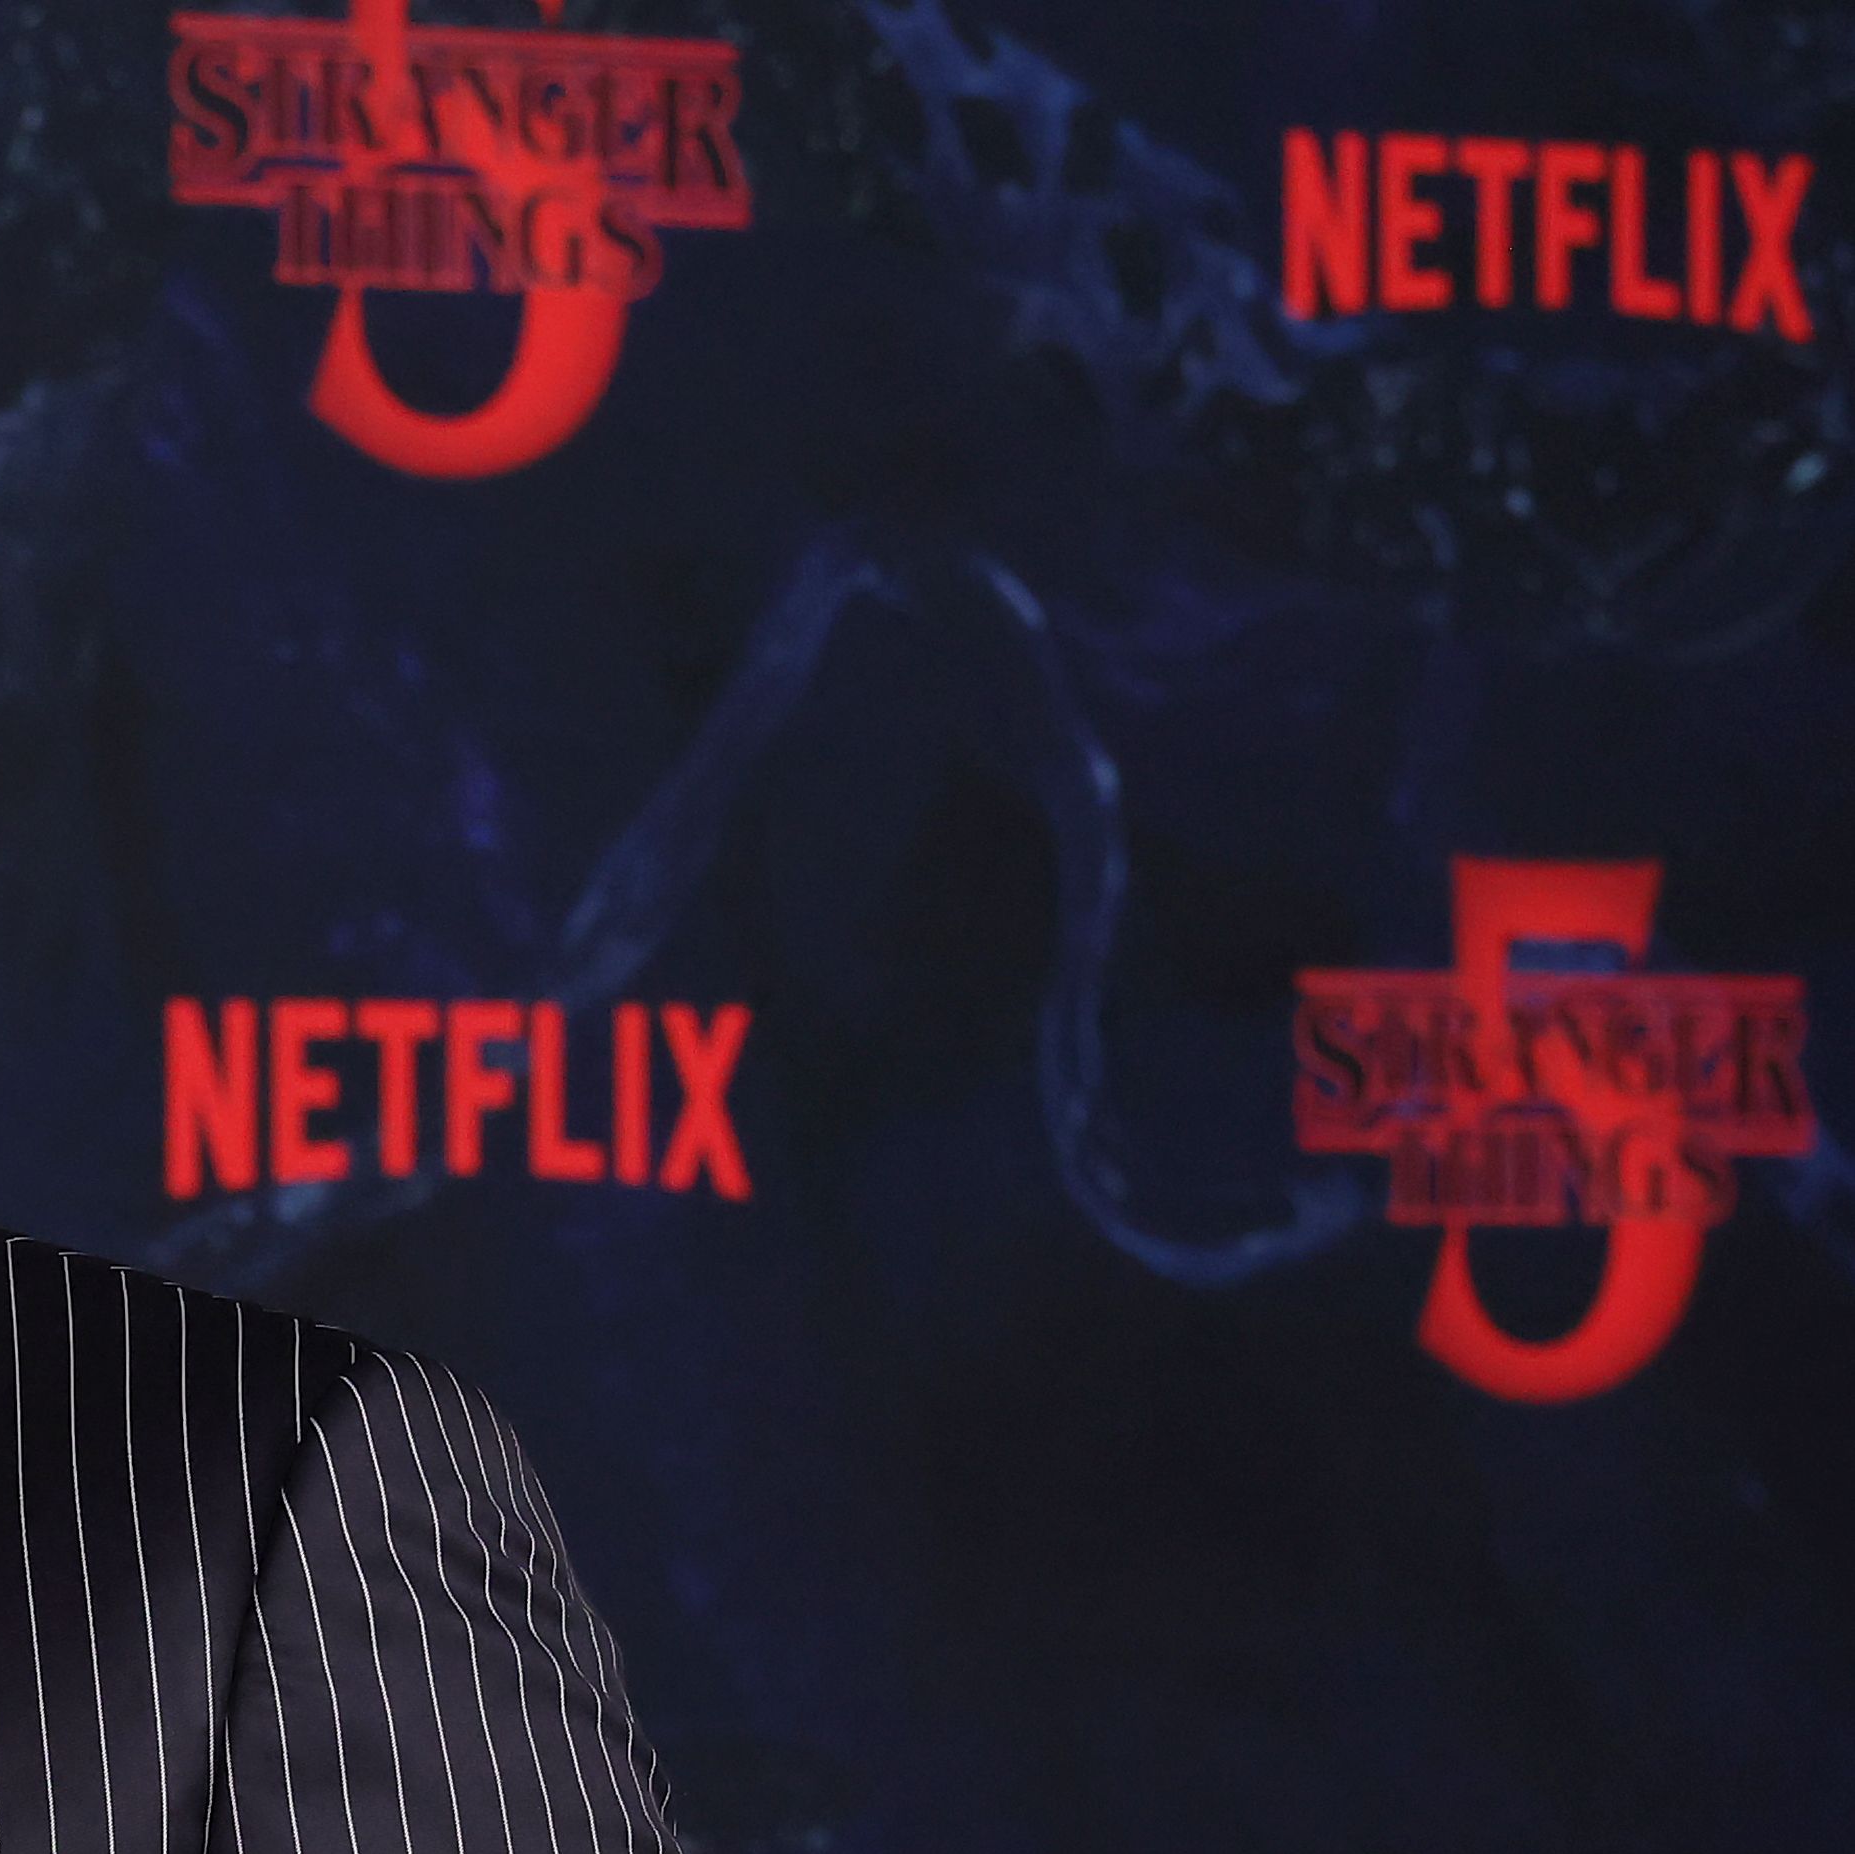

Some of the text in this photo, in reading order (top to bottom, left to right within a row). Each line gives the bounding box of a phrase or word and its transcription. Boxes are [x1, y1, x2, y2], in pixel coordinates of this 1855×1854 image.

[167, 22, 749, 222] STRANGER
[273, 182, 665, 300] THINGS
[1281, 122, 1817, 344] NETFLIX
[163, 994, 753, 1202] NETFLIX
[1293, 976, 1815, 1152] STRANGER
[1387, 1118, 1739, 1228] THINGS
